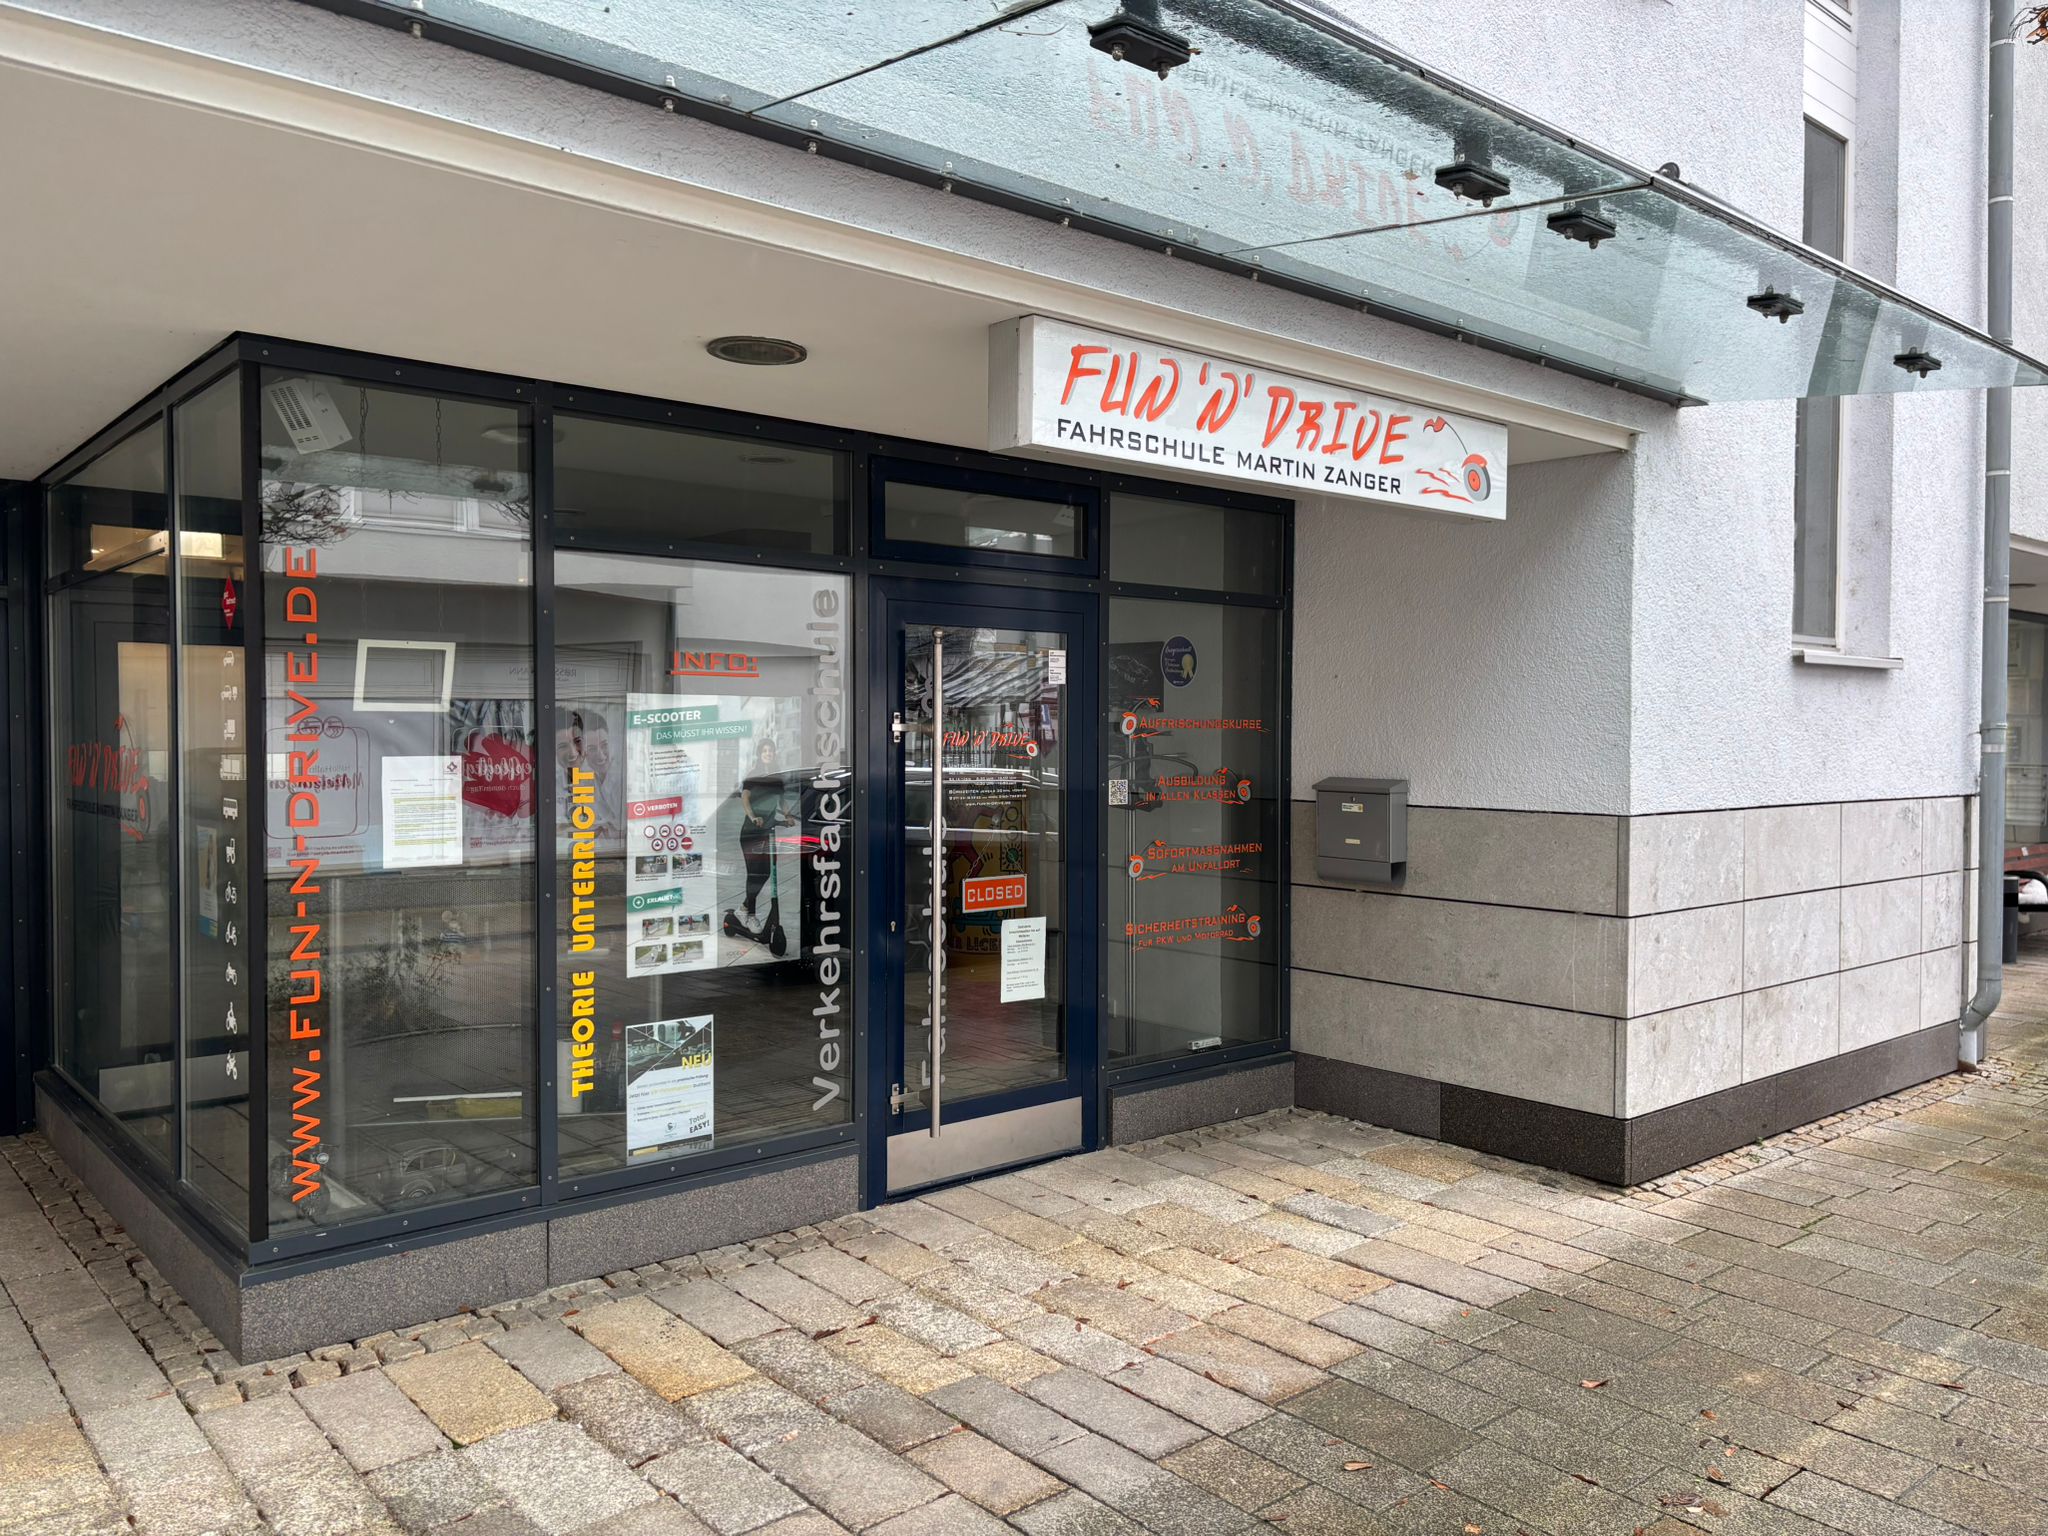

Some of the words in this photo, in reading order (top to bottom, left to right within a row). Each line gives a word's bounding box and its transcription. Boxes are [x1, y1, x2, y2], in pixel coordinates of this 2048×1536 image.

[1060, 342, 1181, 422] FUN
[1261, 385, 1413, 465] DRIVE
[1057, 418, 1225, 466] FAHRSCHULE
[1237, 450, 1316, 481] MARTIN
[1323, 465, 1401, 495] ZANGER
[672, 650, 758, 672] INFO:
[633, 710, 701, 725] E-SCOOTER
[656, 729, 672, 741] DAS
[673, 726, 700, 739] MÜSST
[701, 725, 714, 736] IHR
[715, 724, 748, 736] WISSEN!
[1157, 774, 1227, 788] AUSBILDUNG
[647, 802, 678, 812] VERBOTEN
[809, 588, 842, 1111] Verkehrsfachschule
[572, 767, 596, 952] UNTERRICHT
[1188, 860, 1241, 873] UNFALLORT
[286, 546, 321, 1202] WWW.FUN-N-DRIVE.DE
[967, 884, 1023, 903] CLOSED
[1125, 913, 1246, 936] SICHERHEITSTRAINING
[572, 970, 595, 1098] THEORIE
[681, 1053, 712, 1070] NEU
[689, 1112, 707, 1125] Total
[689, 1120, 710, 1134] EASY!
